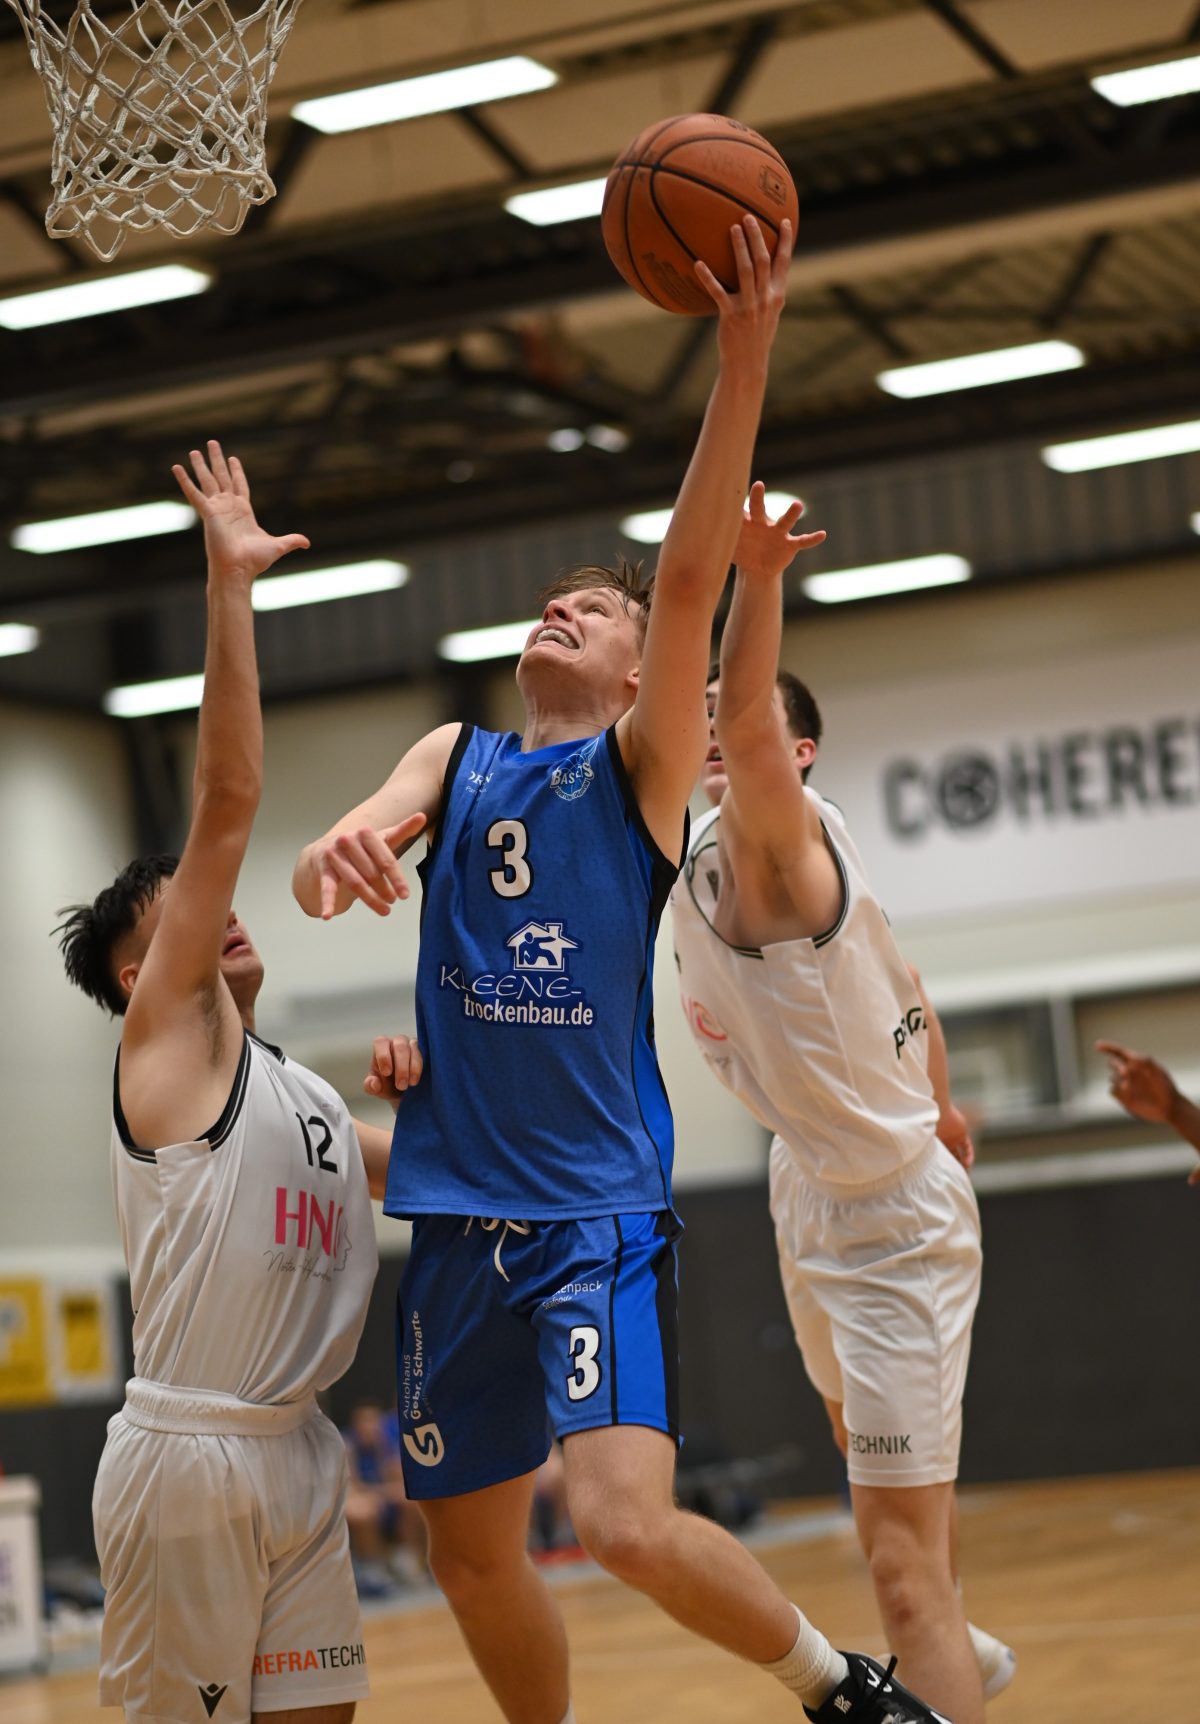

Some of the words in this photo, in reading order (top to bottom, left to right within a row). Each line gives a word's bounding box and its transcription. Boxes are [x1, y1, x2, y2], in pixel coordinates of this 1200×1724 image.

[486, 818, 533, 899] 3
[464, 993, 594, 1026] trockenbau.de
[296, 1111, 338, 1174] 12
[411, 1310, 424, 1377] Schwarte
[566, 1324, 601, 1401] 3
[402, 1354, 411, 1419] Autohaus
[410, 1381, 422, 1420] Gebr.
